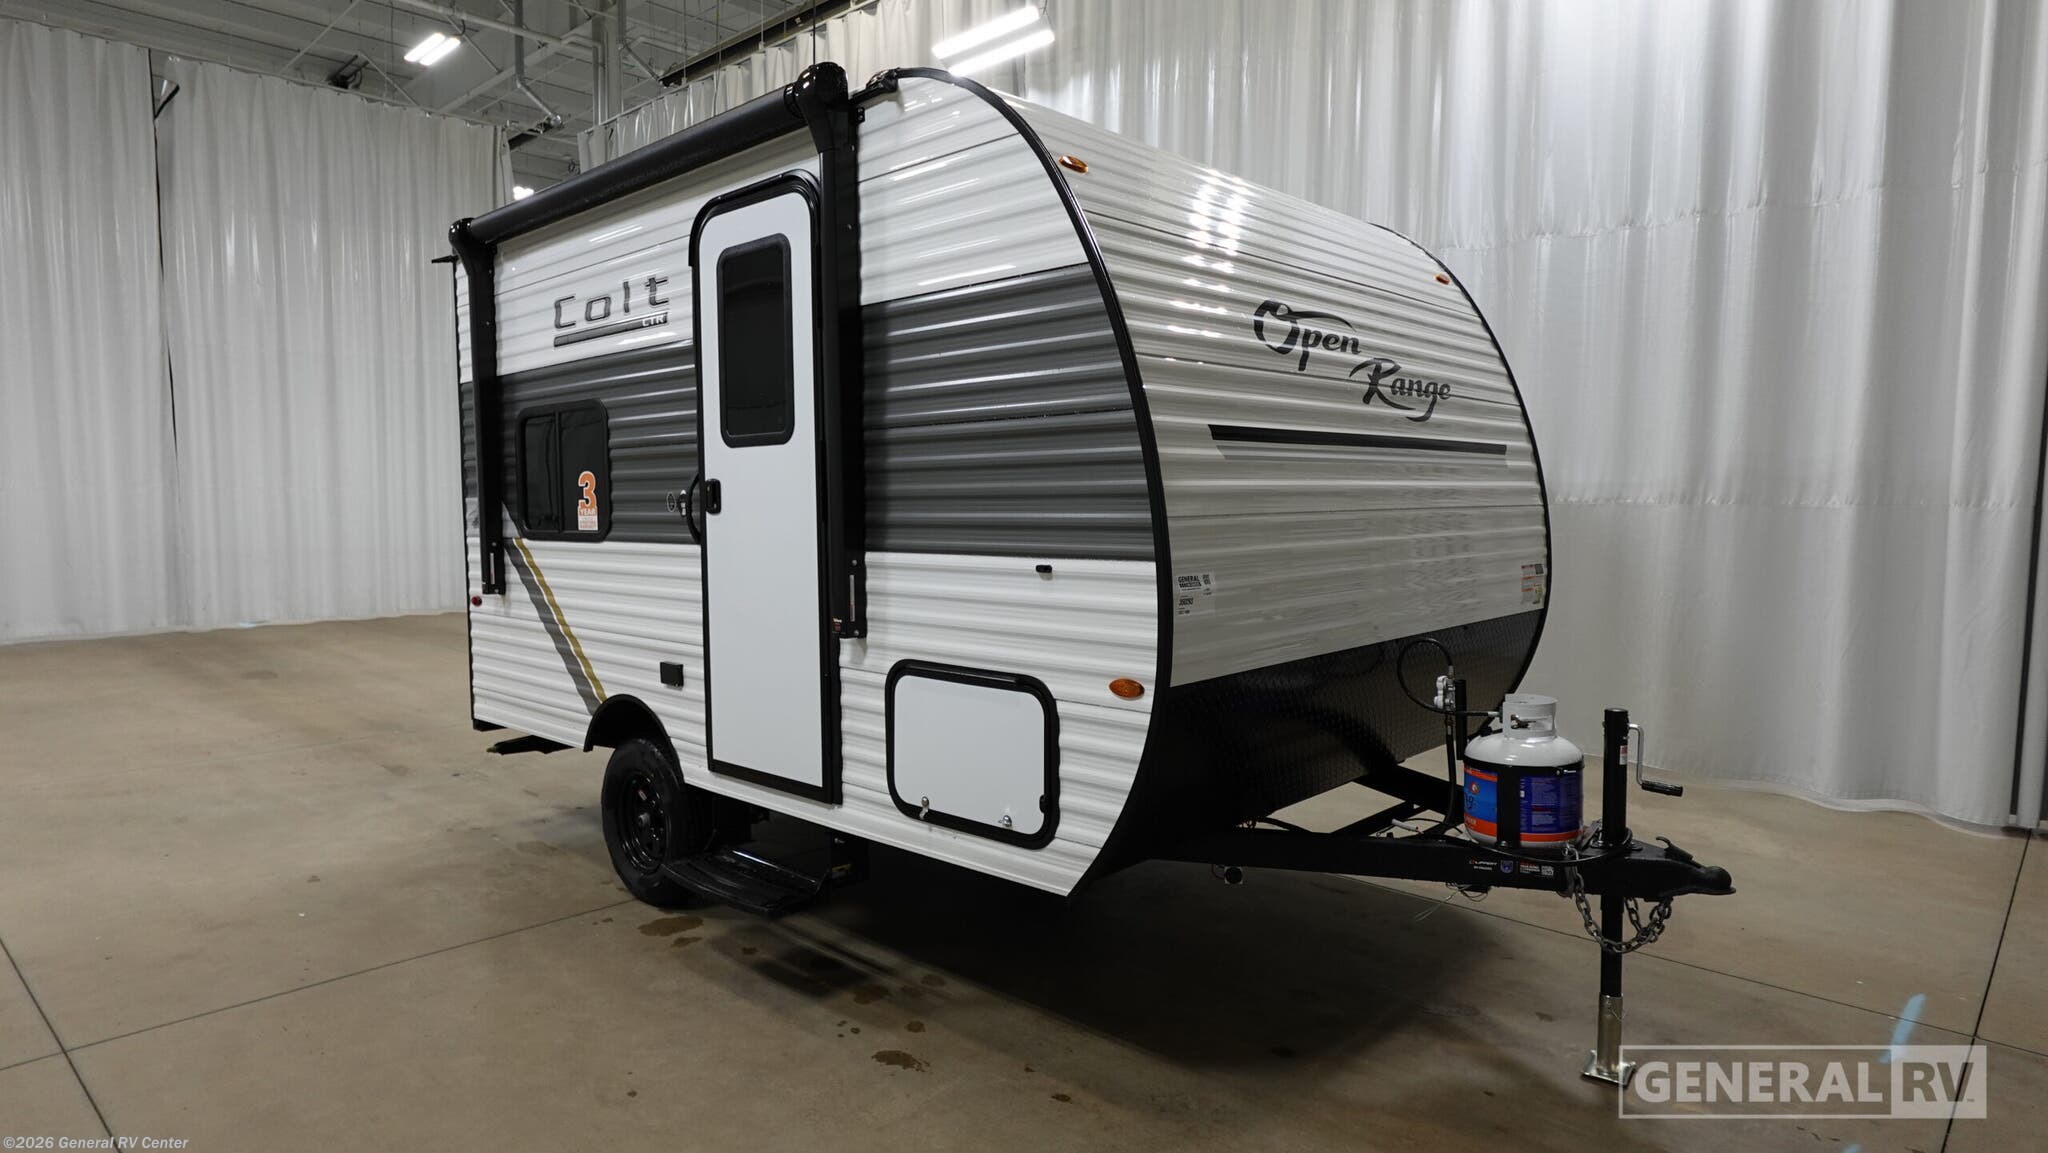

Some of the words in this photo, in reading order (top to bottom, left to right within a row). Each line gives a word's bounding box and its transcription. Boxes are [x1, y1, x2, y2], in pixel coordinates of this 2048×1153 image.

[554, 277, 669, 329] Colt
[642, 314, 665, 327] CTR
[1253, 299, 1363, 372] Open
[1349, 357, 1452, 422] Range
[578, 470, 597, 508] 3
